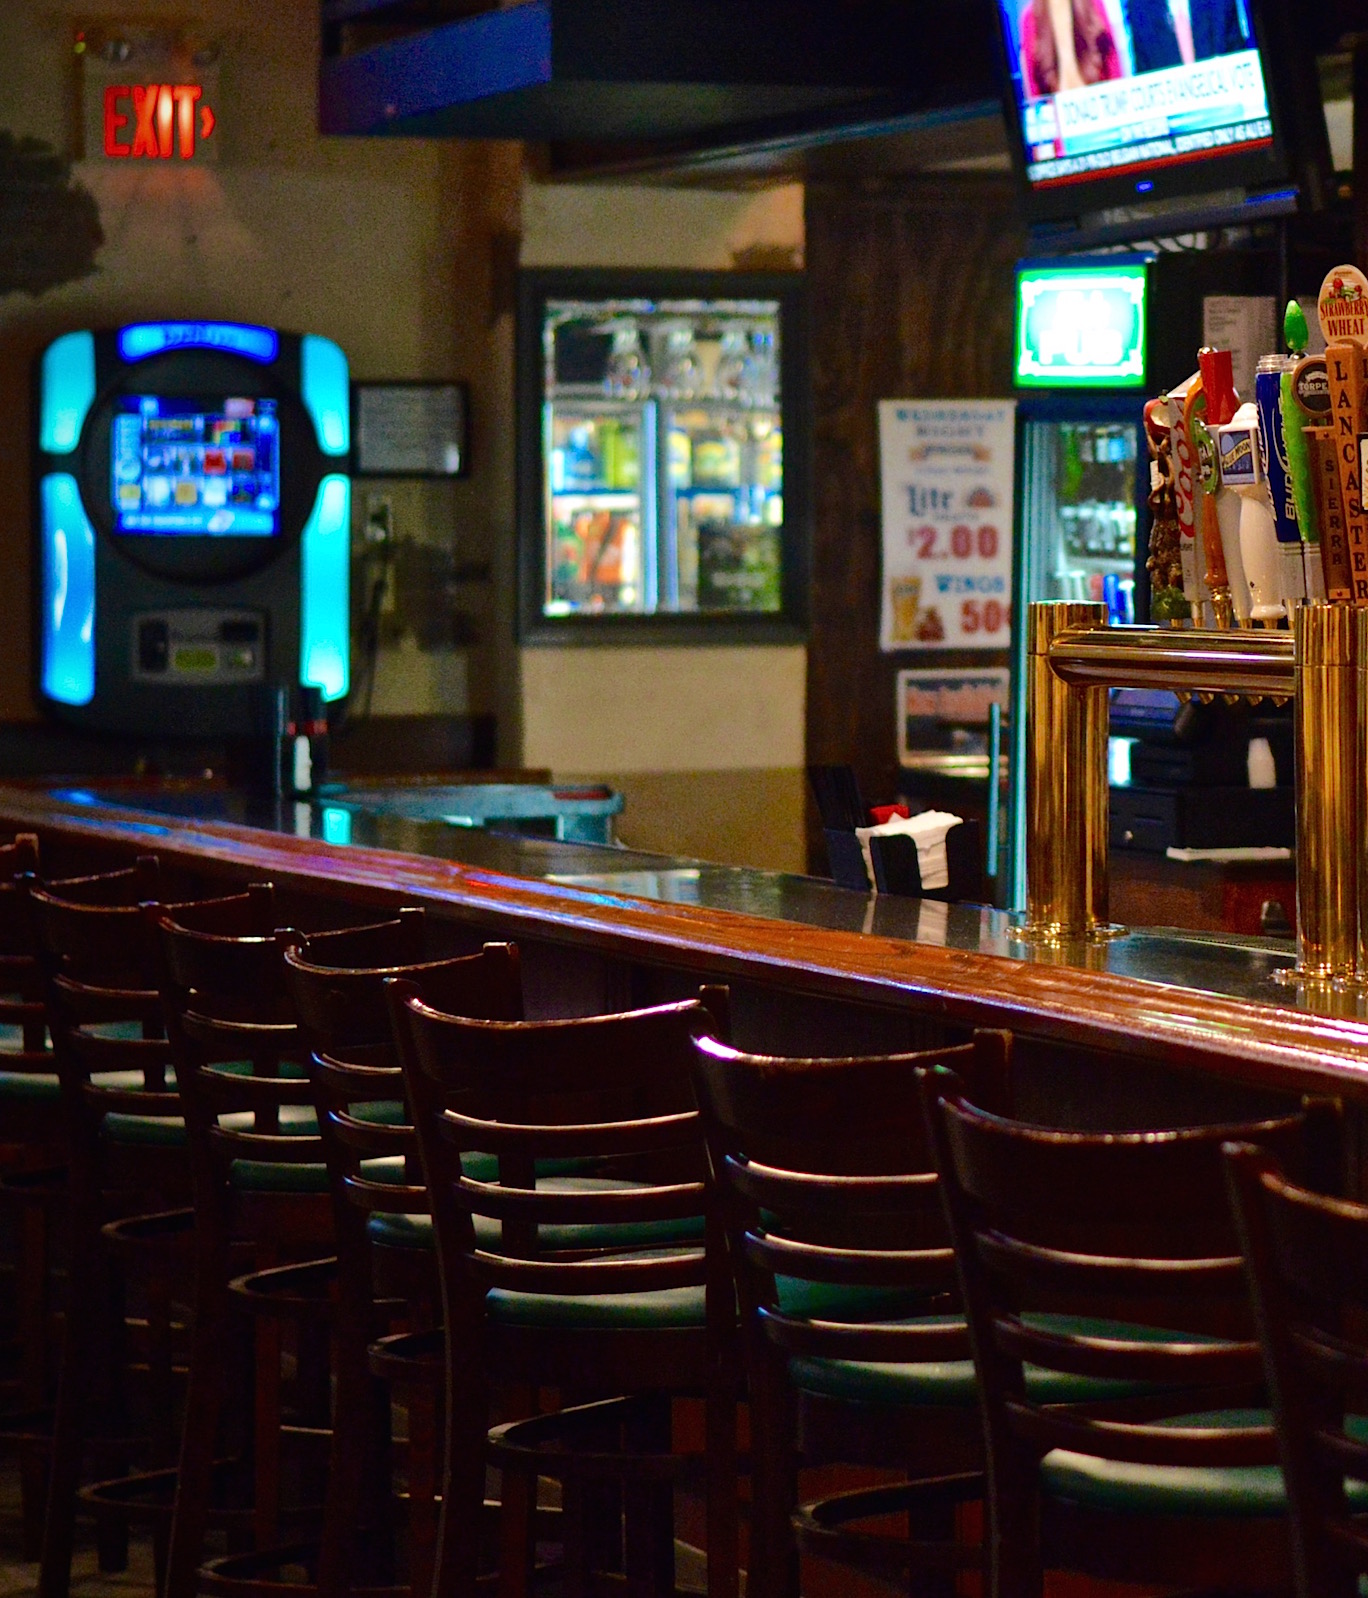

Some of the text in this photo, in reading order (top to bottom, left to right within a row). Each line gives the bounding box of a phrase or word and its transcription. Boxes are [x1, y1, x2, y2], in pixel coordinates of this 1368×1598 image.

[104, 85, 201, 158] EXIT
[1320, 297, 1368, 320] STRAWBERRY
[1327, 318, 1364, 336] WHEAT
[1298, 382, 1328, 391] TORPE
[1325, 460, 1342, 567] SIERRA
[907, 526, 999, 560] $2.00
[935, 575, 1005, 593] WINGS
